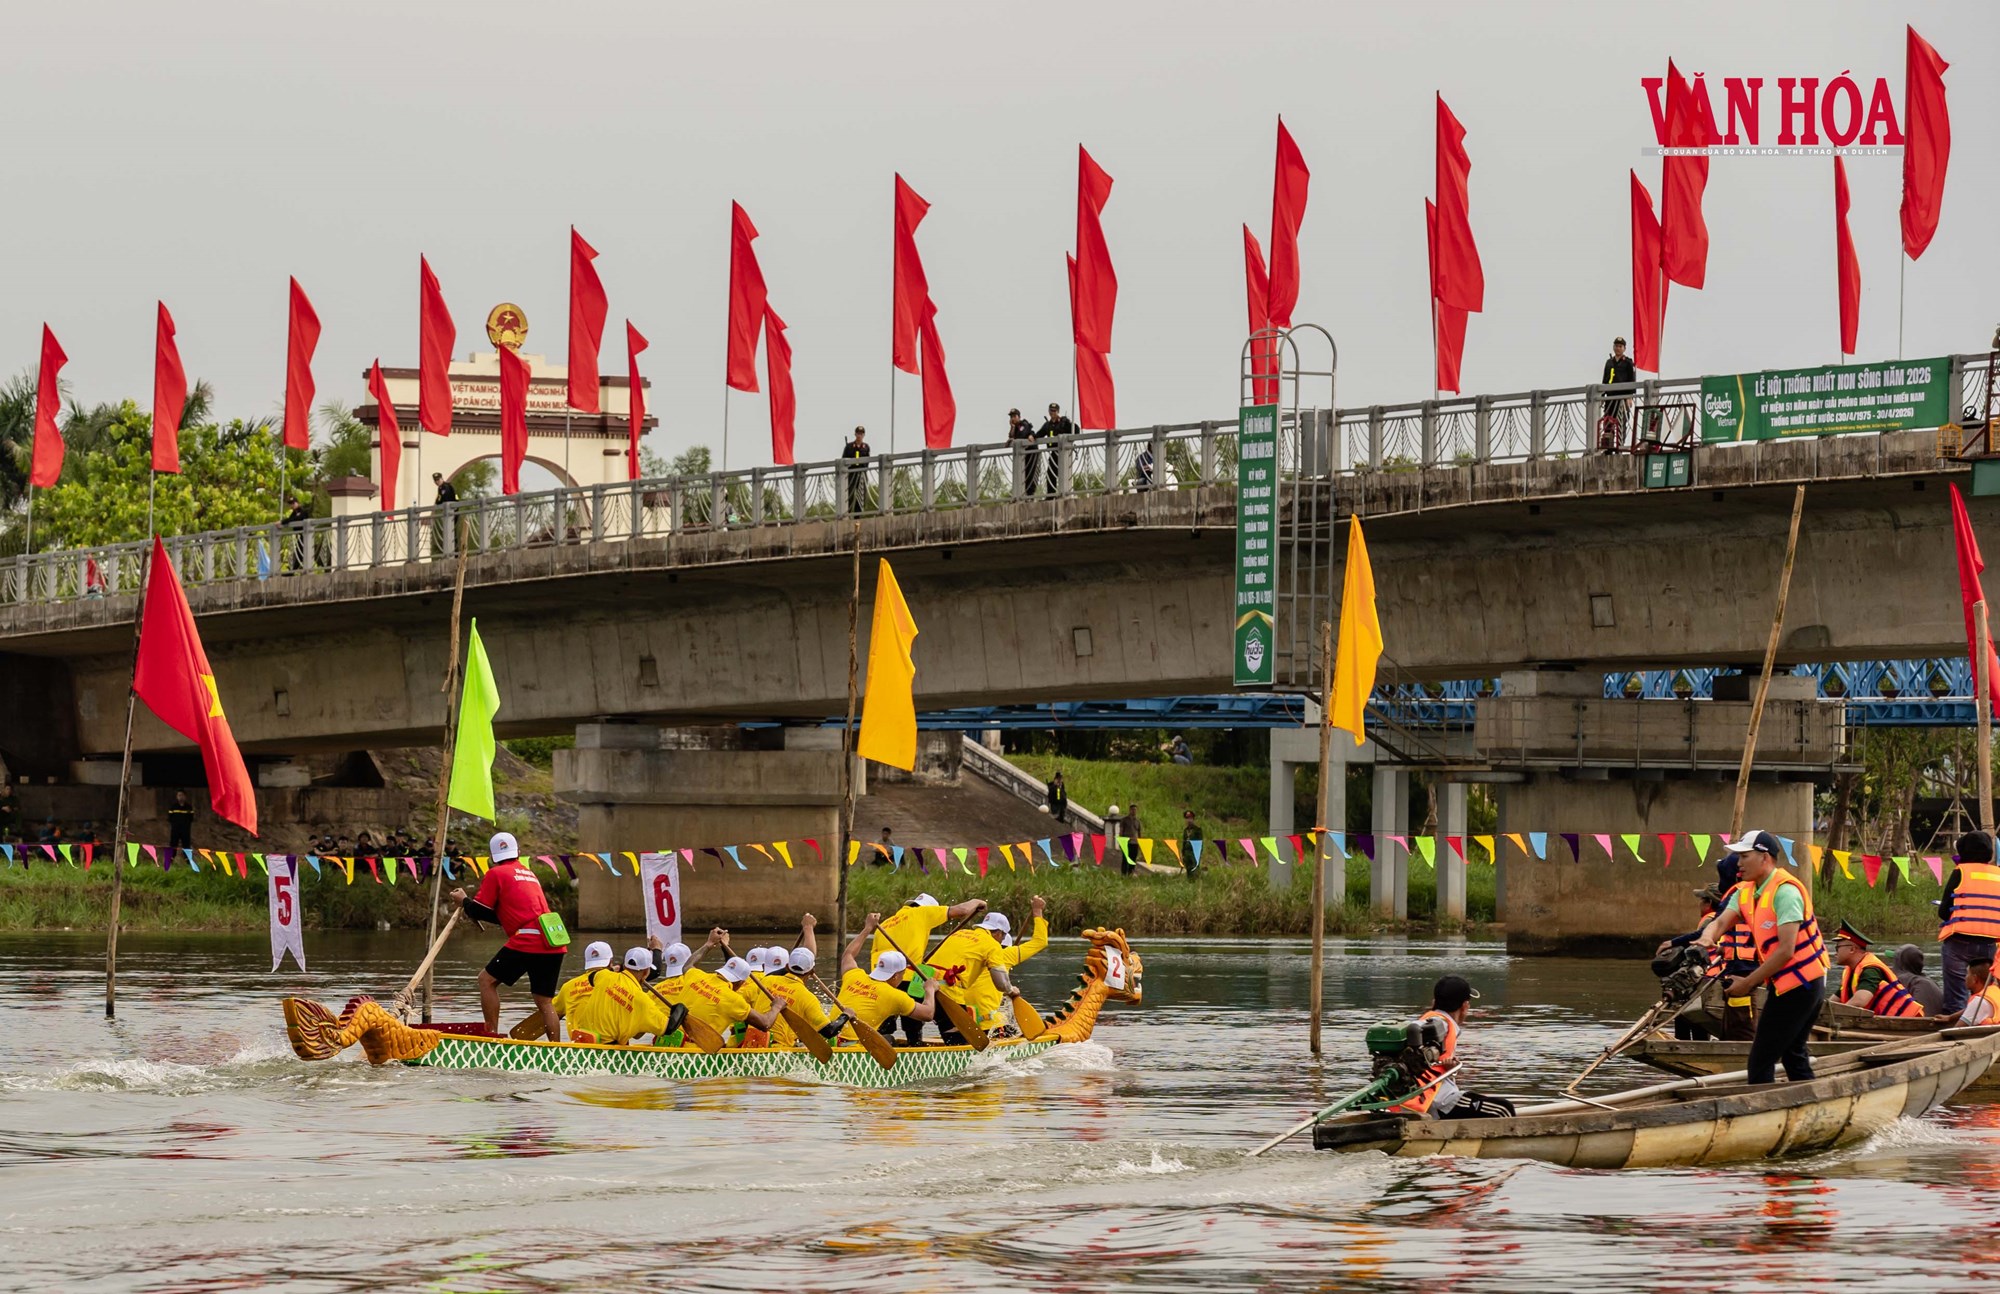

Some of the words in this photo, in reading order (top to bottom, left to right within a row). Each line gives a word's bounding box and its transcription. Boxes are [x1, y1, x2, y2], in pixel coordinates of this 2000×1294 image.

[452, 382, 468, 394] VIỆT
[550, 384, 568, 396] NHẤ
[1755, 375, 1766, 397] LỄ
[1767, 376, 1782, 399] HỘI
[1784, 373, 1811, 394] THỐNG
[1813, 370, 1836, 392] NHẤT
[1838, 373, 1856, 390] NON
[1858, 368, 1880, 389] SÔNG
[1884, 366, 1904, 387] NĂM
[1907, 367, 1931, 385] 2026
[1705, 392, 1732, 416] Carlsberg
[1786, 402, 1792, 412] 51
[1910, 392, 1924, 402] NAM
[1717, 418, 1736, 426] Vietnam
[274, 876, 292, 926] 5
[653, 874, 676, 926] 6
[1112, 956, 1121, 978] 2
